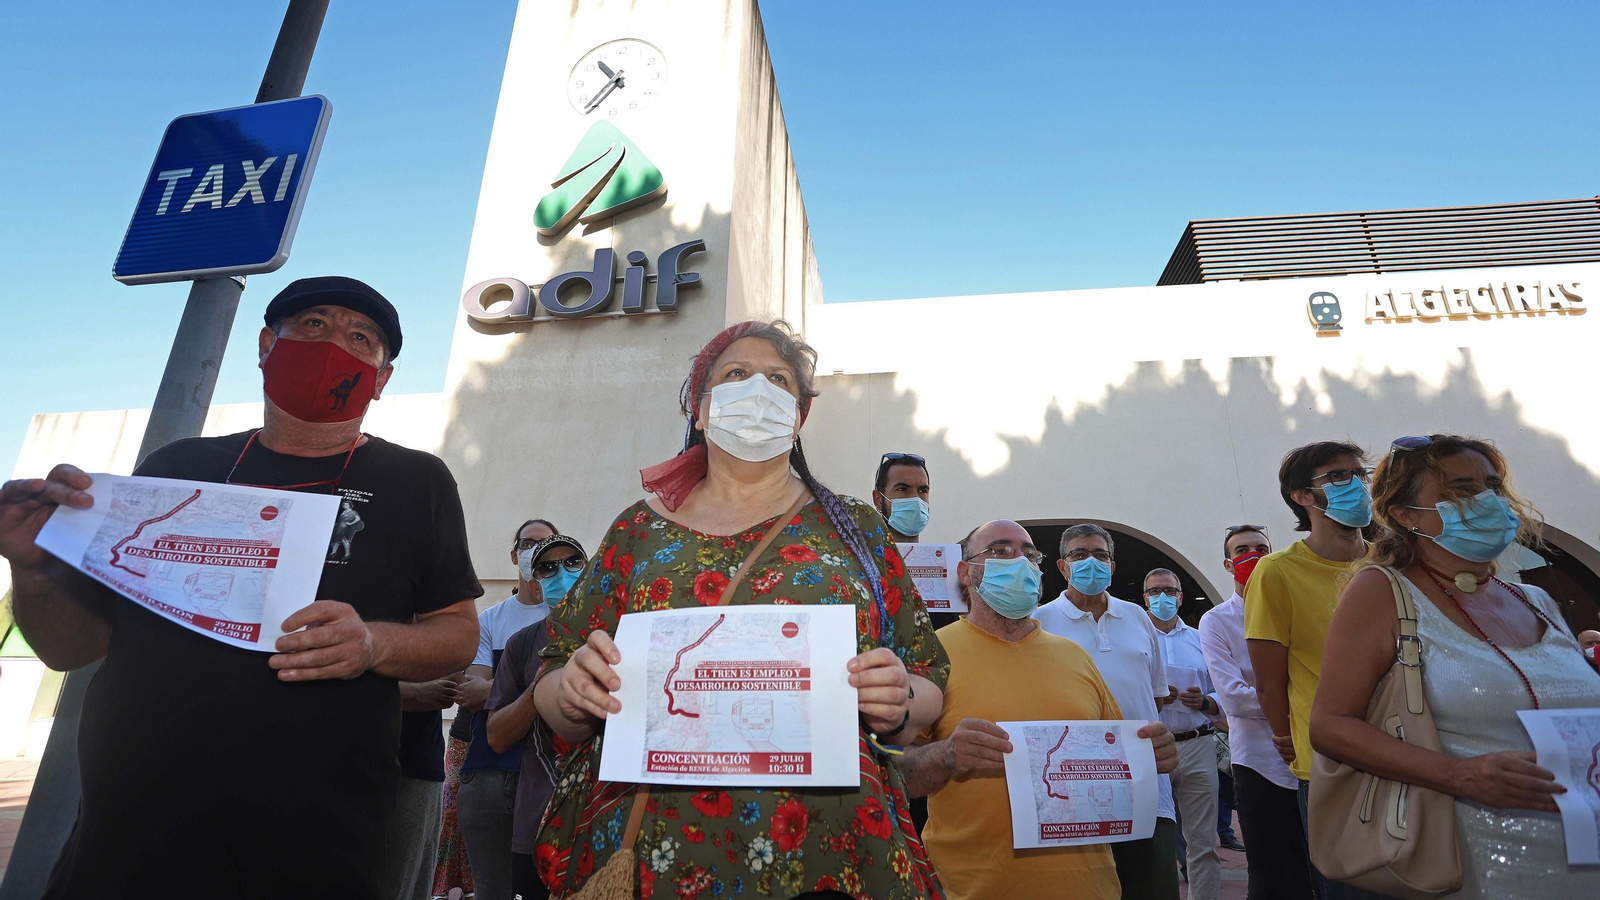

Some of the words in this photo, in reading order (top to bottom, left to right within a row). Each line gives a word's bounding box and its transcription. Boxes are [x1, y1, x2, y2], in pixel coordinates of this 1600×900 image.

[156, 153, 298, 216] TAXI
[462, 238, 707, 323] adif
[1364, 281, 1588, 323] ALGECIRAS
[158, 541, 171, 550] EL
[173, 543, 202, 553] TREN
[204, 545, 217, 553] ES
[219, 546, 262, 556] EMPLEO
[263, 548, 270, 556] Y
[127, 547, 201, 563] DESARROLLO
[202, 556, 268, 568] SOSTENIBLE
[212, 626, 240, 638] 10:30
[241, 632, 251, 640] H
[225, 623, 253, 632] JULIO
[697, 669, 710, 678] EL
[711, 669, 738, 678] TREN
[740, 669, 751, 678] ES
[753, 669, 793, 678] EMPLEO
[794, 669, 801, 678] Y
[676, 681, 740, 691] DESARROLLO
[741, 681, 801, 690] SOSTENIBLE
[651, 752, 750, 765] CONCENTRACIÓN
[769, 755, 779, 763] 29
[779, 755, 804, 763] JULIO
[650, 764, 678, 772] Estación
[680, 764, 687, 772] de
[721, 765, 750, 774] Algeciras
[768, 764, 794, 773] 10:30
[795, 764, 804, 773] H
[1043, 822, 1100, 832] CONCENTRACIÓN
